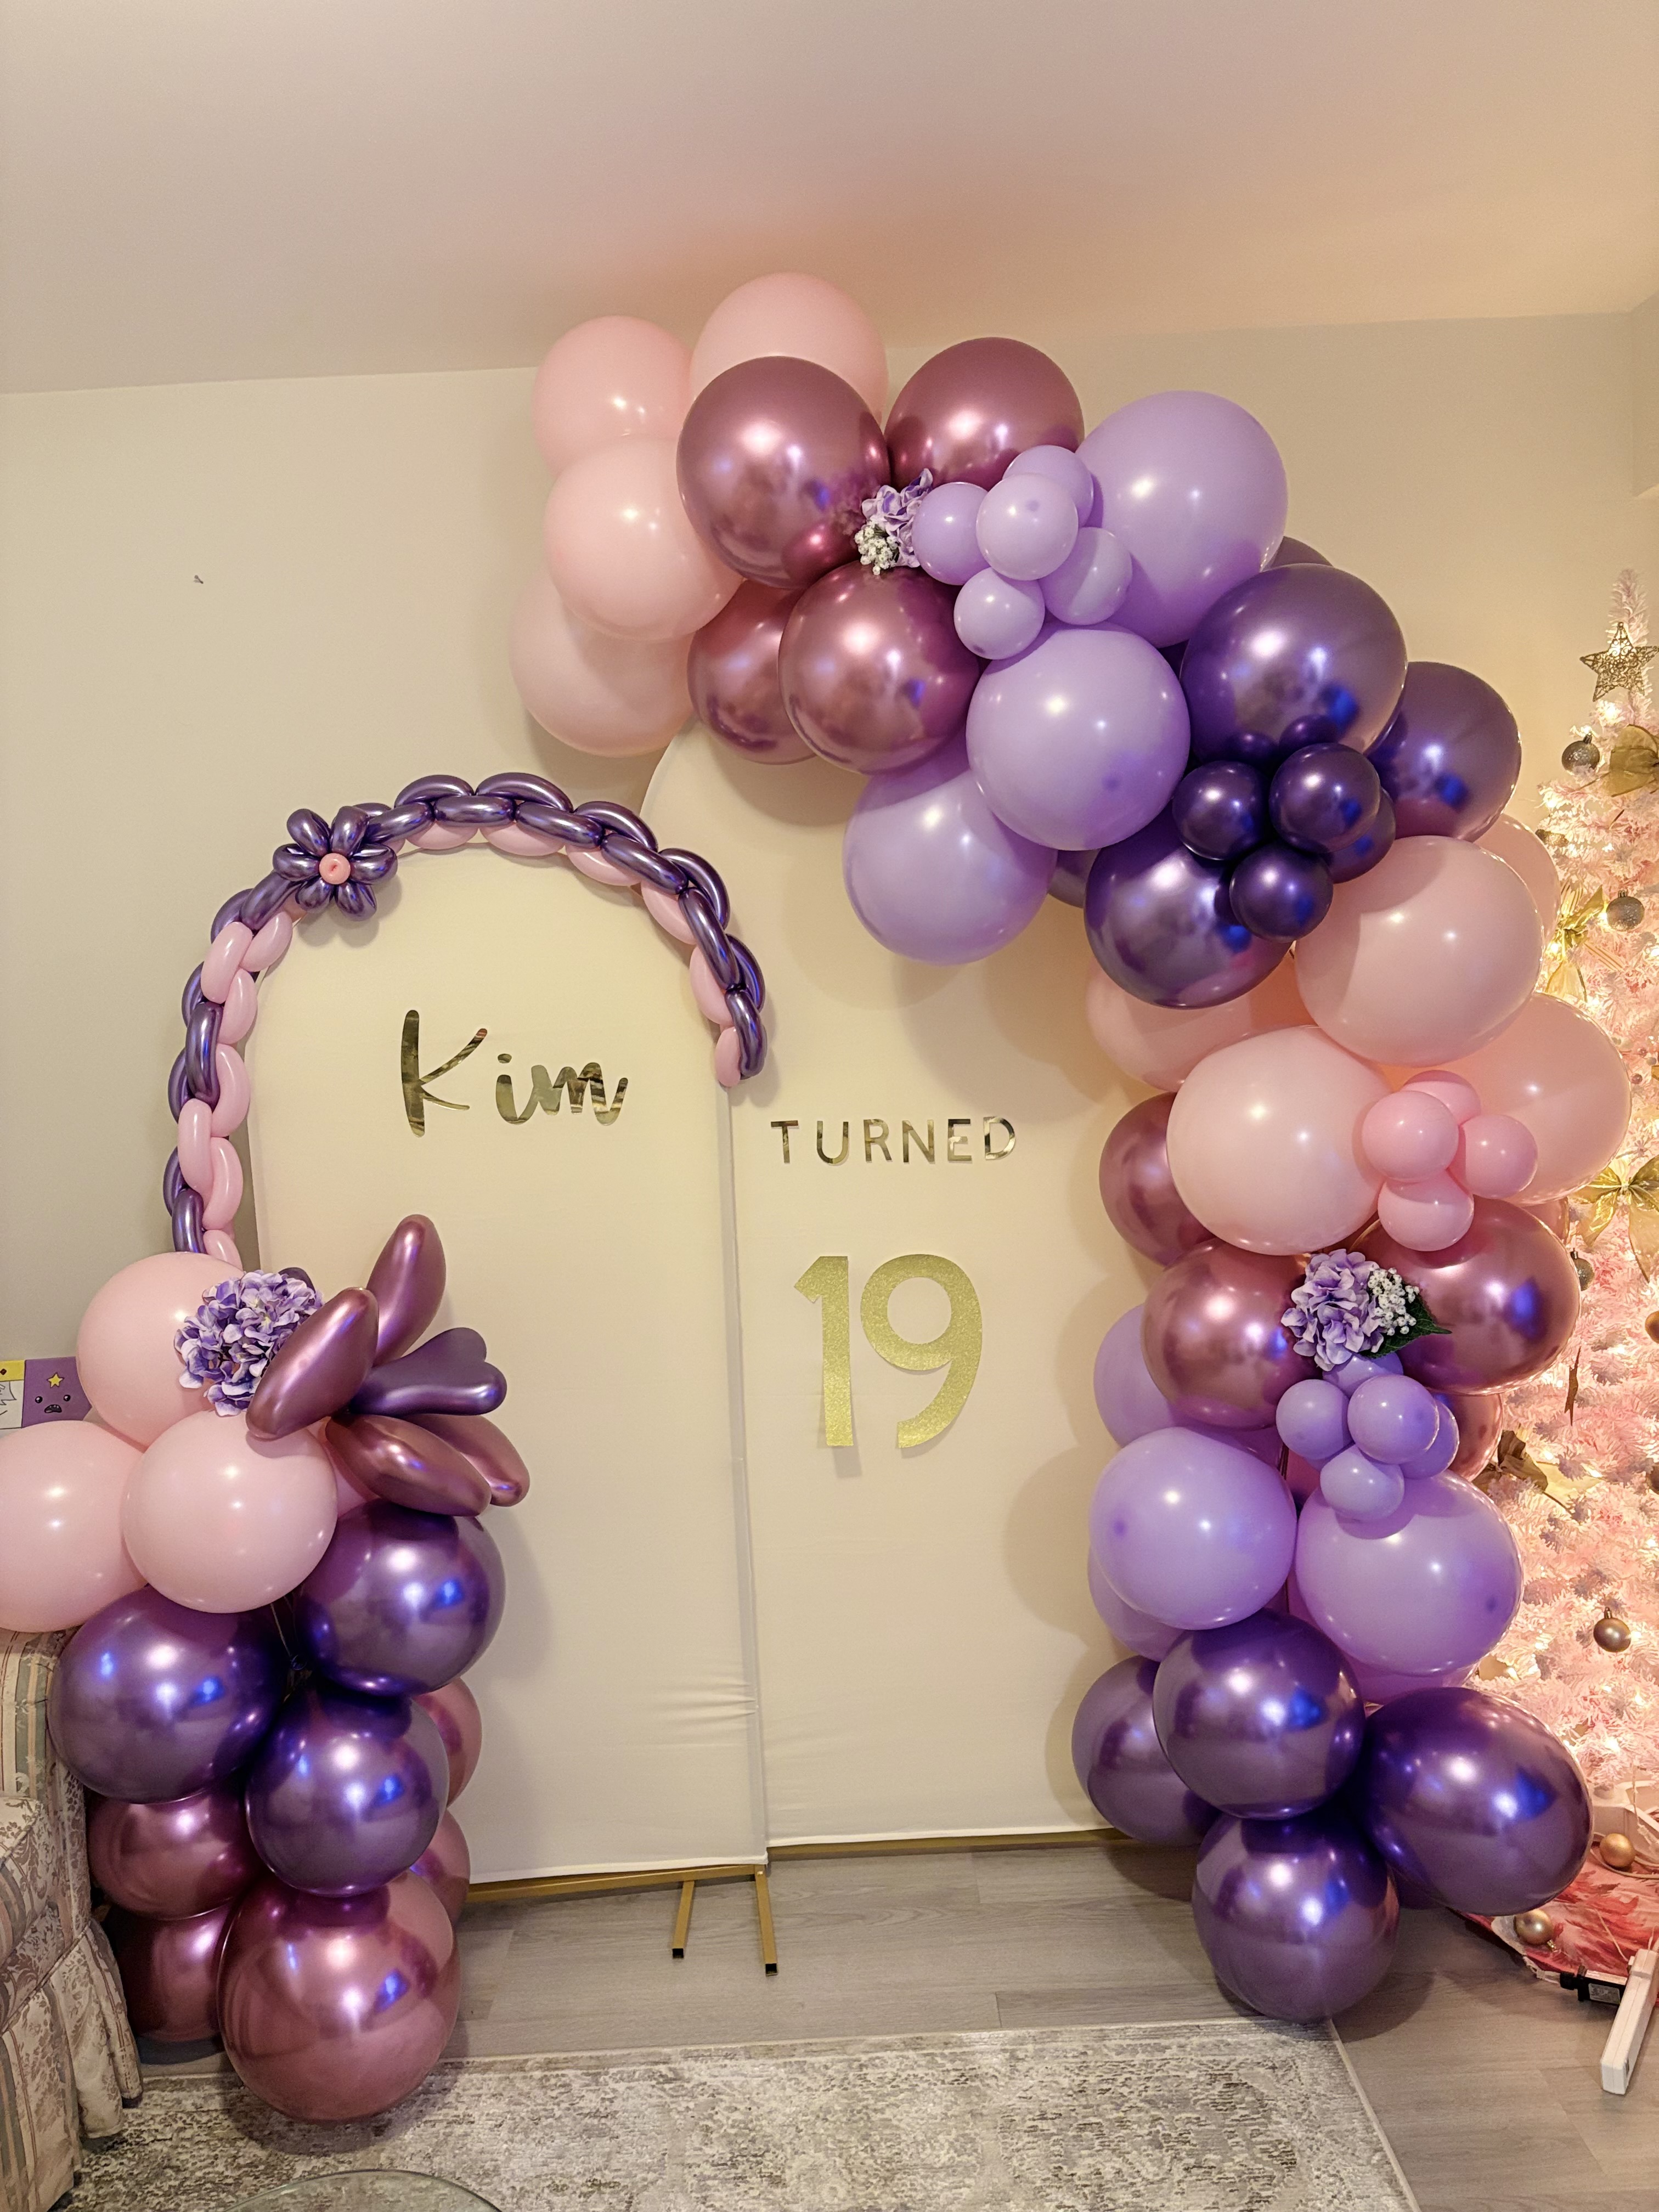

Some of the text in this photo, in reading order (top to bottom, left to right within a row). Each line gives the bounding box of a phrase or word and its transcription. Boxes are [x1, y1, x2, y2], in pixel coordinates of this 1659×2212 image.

[401, 1010, 628, 1137] Kim
[770, 1116, 1016, 1165] TURNED
[794, 1254, 983, 1448] 19
